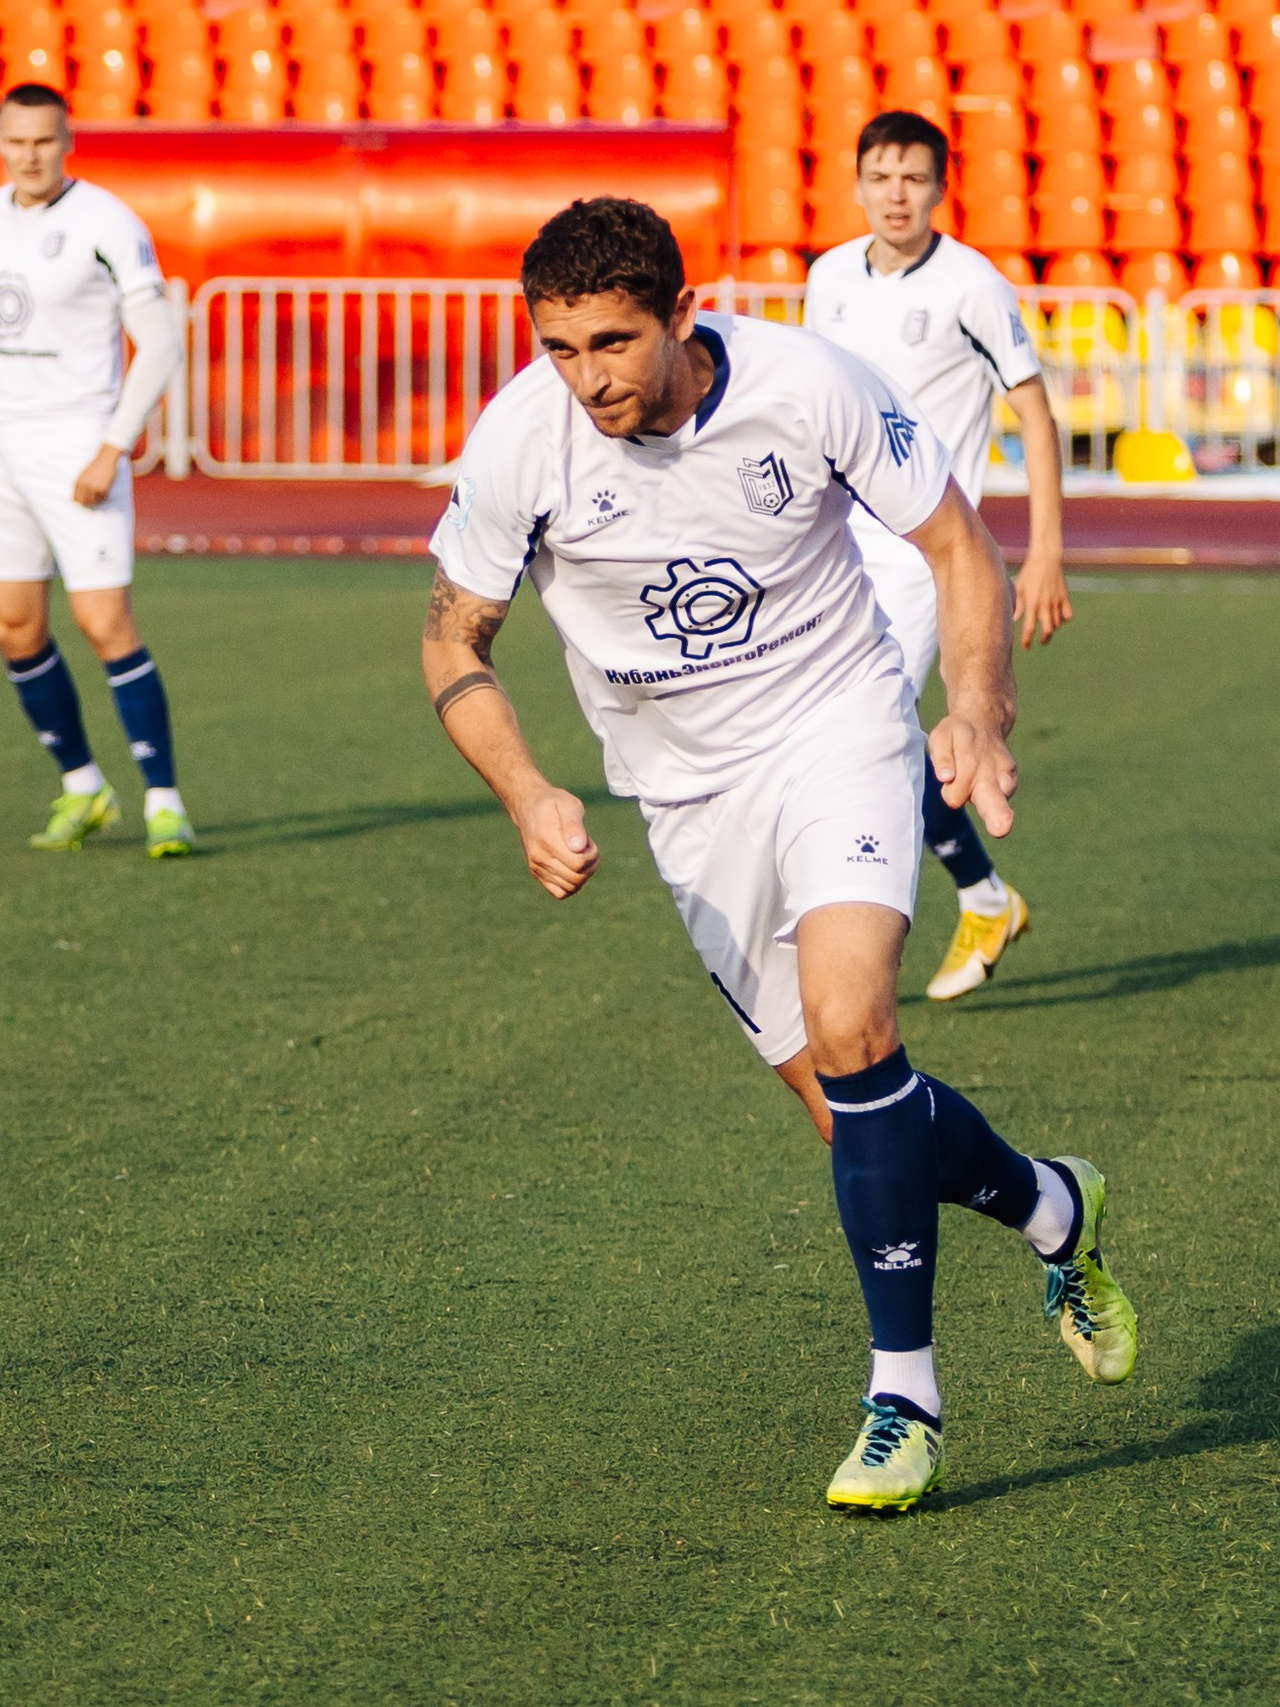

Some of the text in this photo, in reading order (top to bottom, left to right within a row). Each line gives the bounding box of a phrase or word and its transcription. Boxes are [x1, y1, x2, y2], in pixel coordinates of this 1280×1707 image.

[587, 509, 629, 526] KELME
[604, 610, 825, 685] КубаньЭнергоРемонт
[846, 855, 889, 866] KELME
[873, 1258, 923, 1271] KELME
